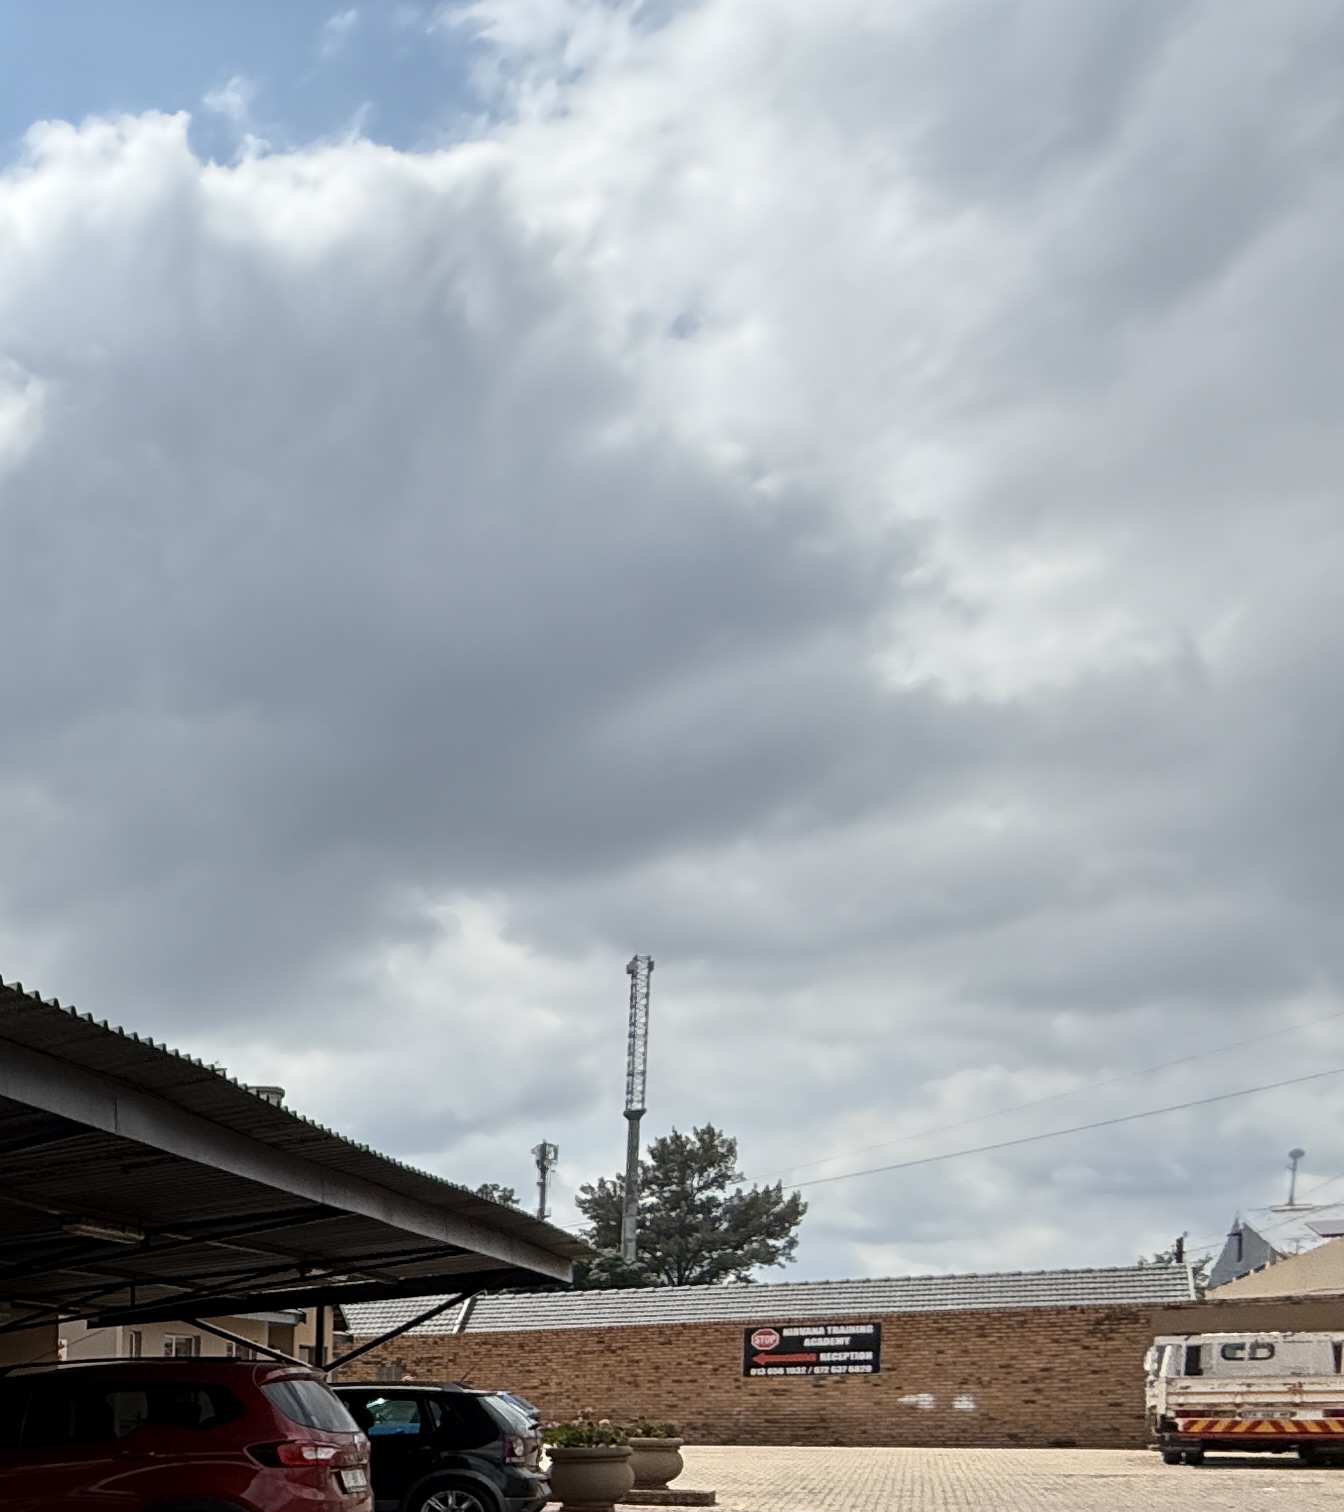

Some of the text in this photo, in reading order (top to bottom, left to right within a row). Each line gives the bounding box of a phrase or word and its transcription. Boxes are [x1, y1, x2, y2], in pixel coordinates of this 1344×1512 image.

[782, 1325, 873, 1336] NIRVANA TRAINING
[754, 1334, 776, 1345] STOP
[803, 1337, 850, 1346] ACADEMY
[820, 1352, 873, 1361] RECEPTION
